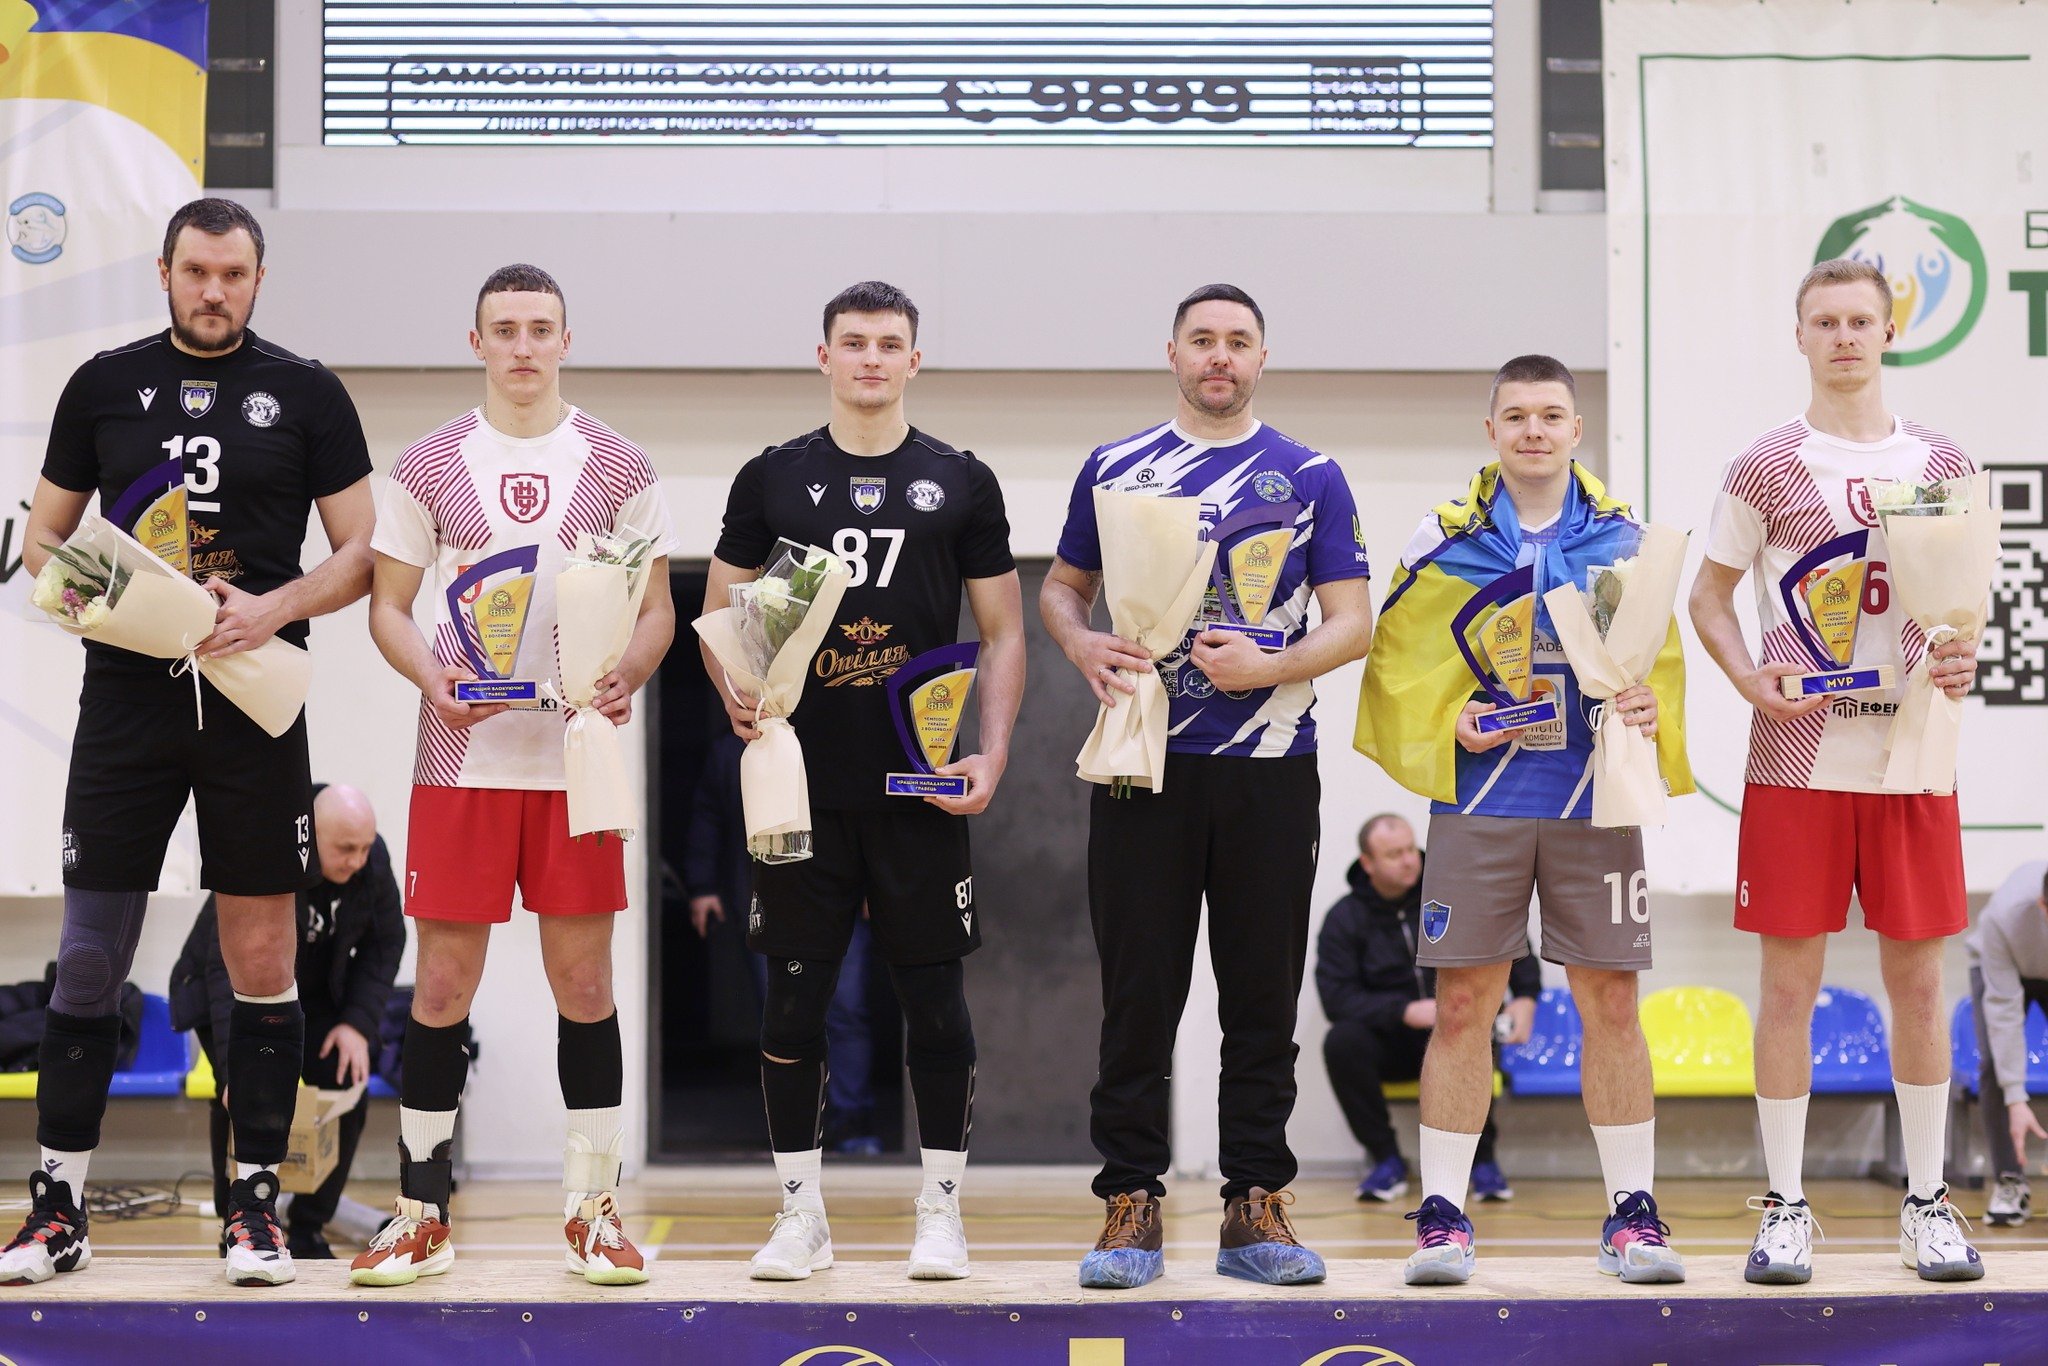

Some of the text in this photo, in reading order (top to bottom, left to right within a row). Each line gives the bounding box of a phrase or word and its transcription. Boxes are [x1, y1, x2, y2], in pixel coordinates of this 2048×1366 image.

[1031, 78, 1250, 124] 9899
[832, 527, 906, 588] 87
[1824, 595, 1850, 605] ФВУ
[1861, 561, 1890, 615] 6
[1826, 677, 1854, 689] MVP
[928, 702, 951, 710] ФВУ
[294, 814, 309, 844] 13
[409, 871, 418, 898] 7
[955, 876, 973, 910] 87
[1603, 869, 1650, 925] 16
[1739, 880, 1749, 908] 6
